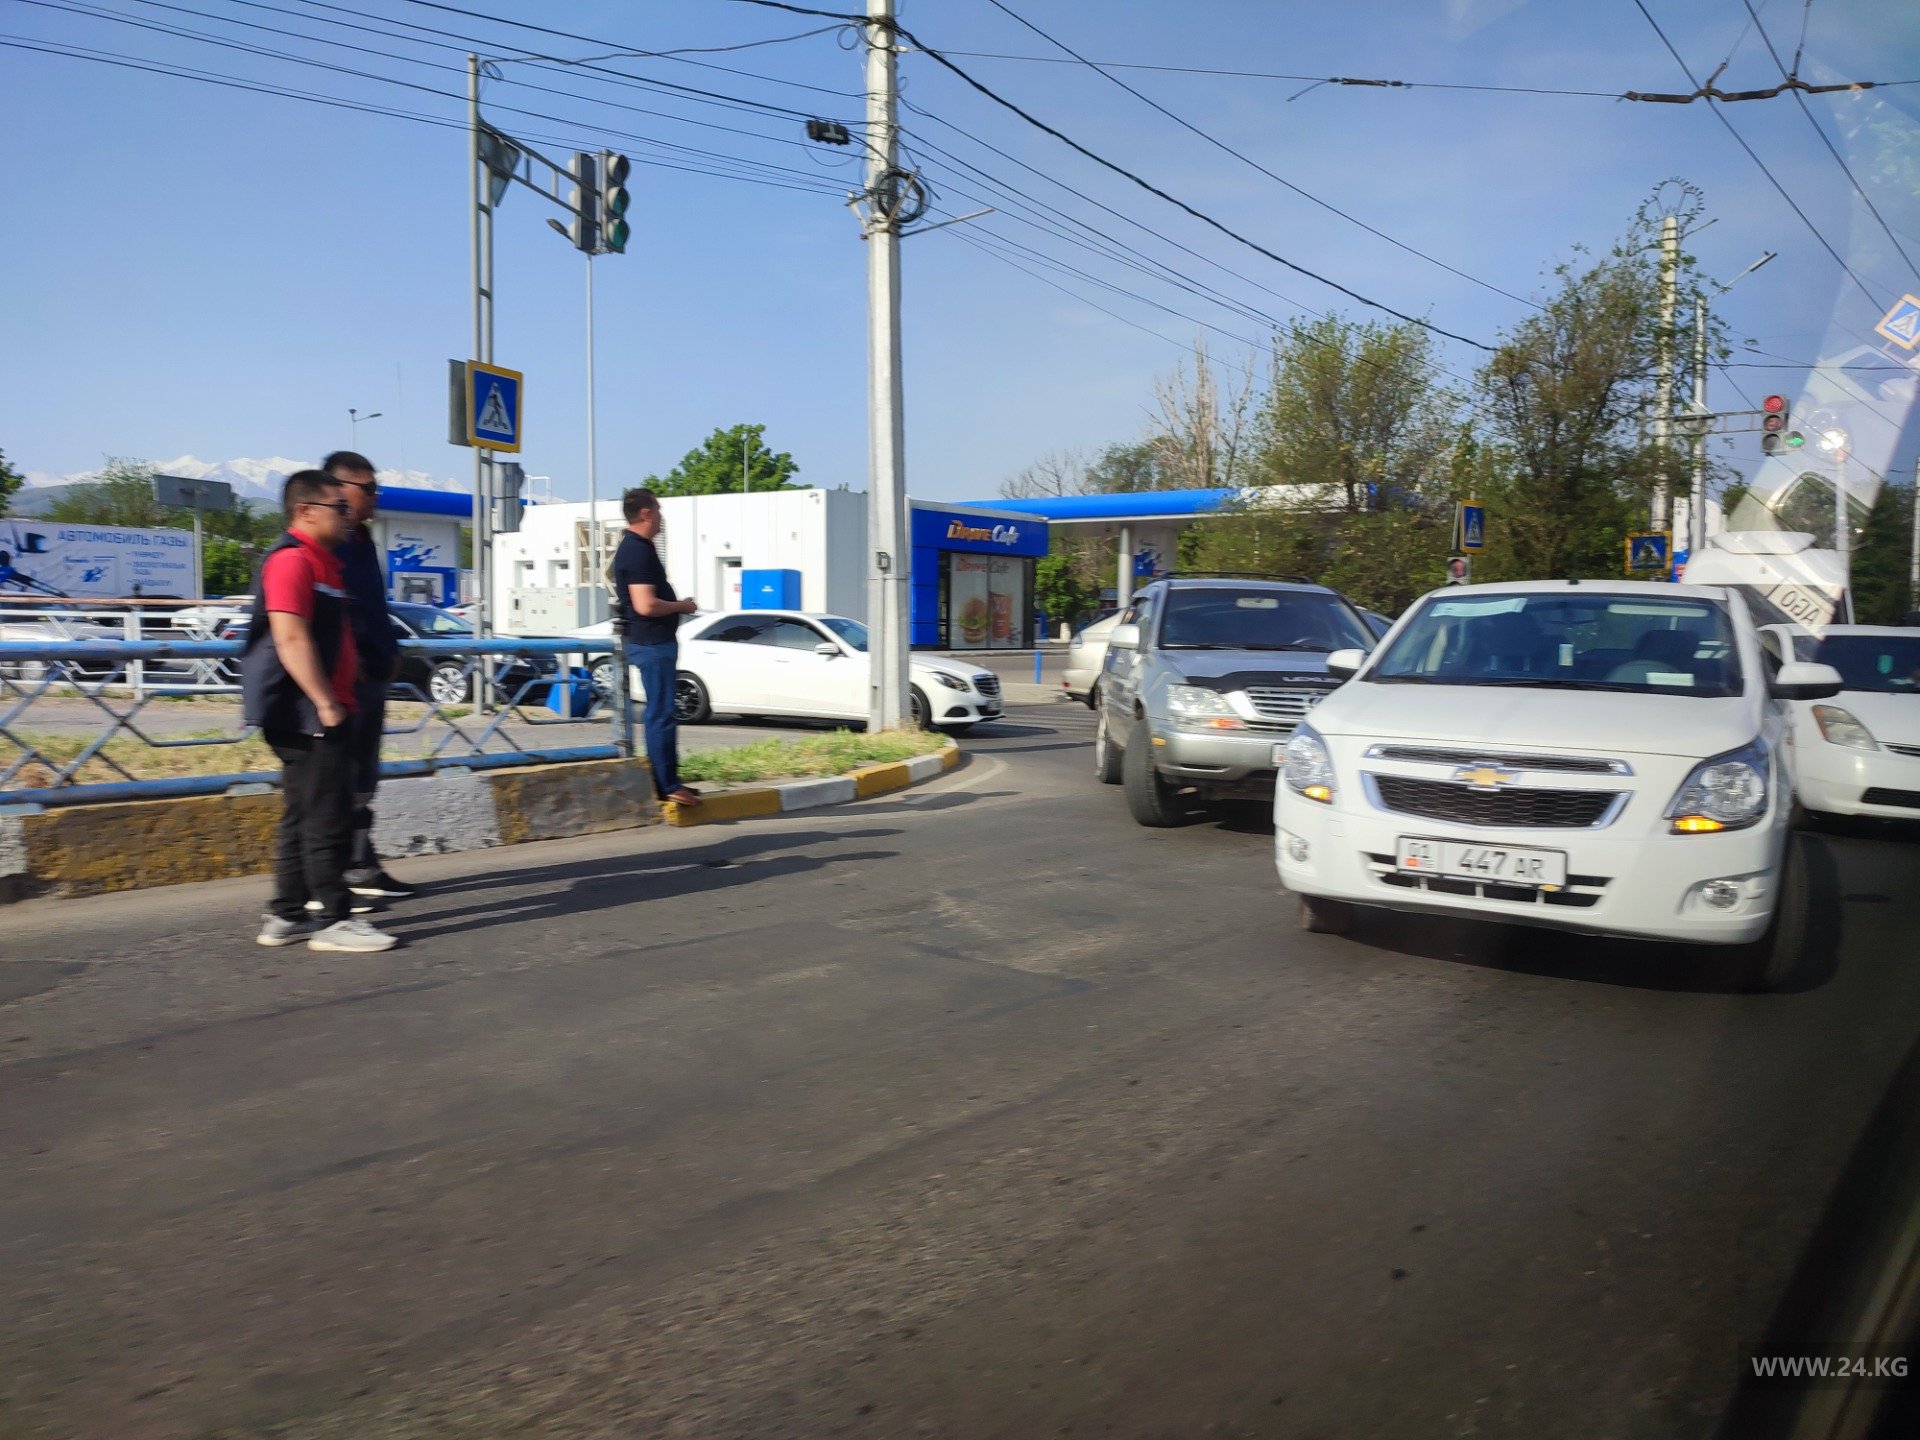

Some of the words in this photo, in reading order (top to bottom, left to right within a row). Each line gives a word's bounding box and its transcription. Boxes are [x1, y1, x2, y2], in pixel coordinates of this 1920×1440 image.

[57, 530, 150, 546] АВТОМОБИЛЬ
[153, 535, 188, 547] ГАЗЫ
[1458, 848, 1507, 875] 447
